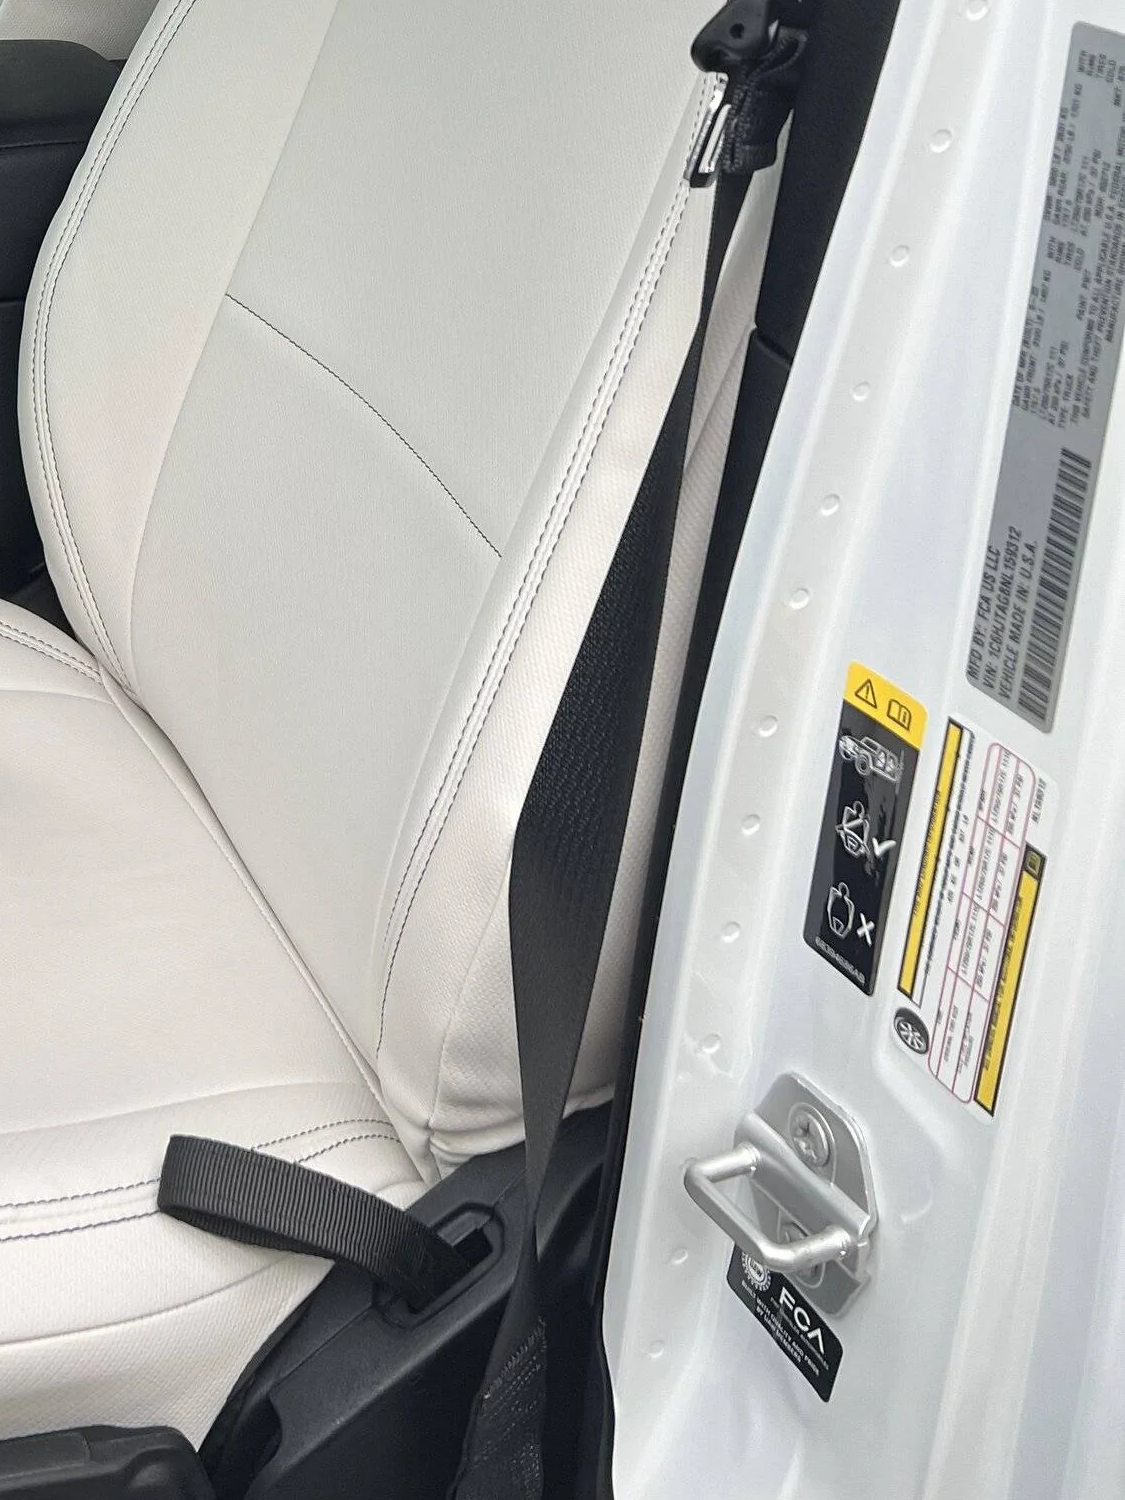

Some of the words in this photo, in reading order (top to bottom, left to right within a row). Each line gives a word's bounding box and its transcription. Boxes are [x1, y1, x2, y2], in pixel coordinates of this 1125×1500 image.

[986, 546, 1000, 571] LLC
[982, 573, 995, 592] US
[978, 595, 991, 620] FCA
[973, 624, 987, 647] BY:
[967, 648, 982, 679] MFD
[998, 646, 1018, 699] VEHICLE
[1009, 605, 1025, 644] MADE
[983, 662, 997, 689] VIN:
[779, 1286, 824, 1354] FCA
